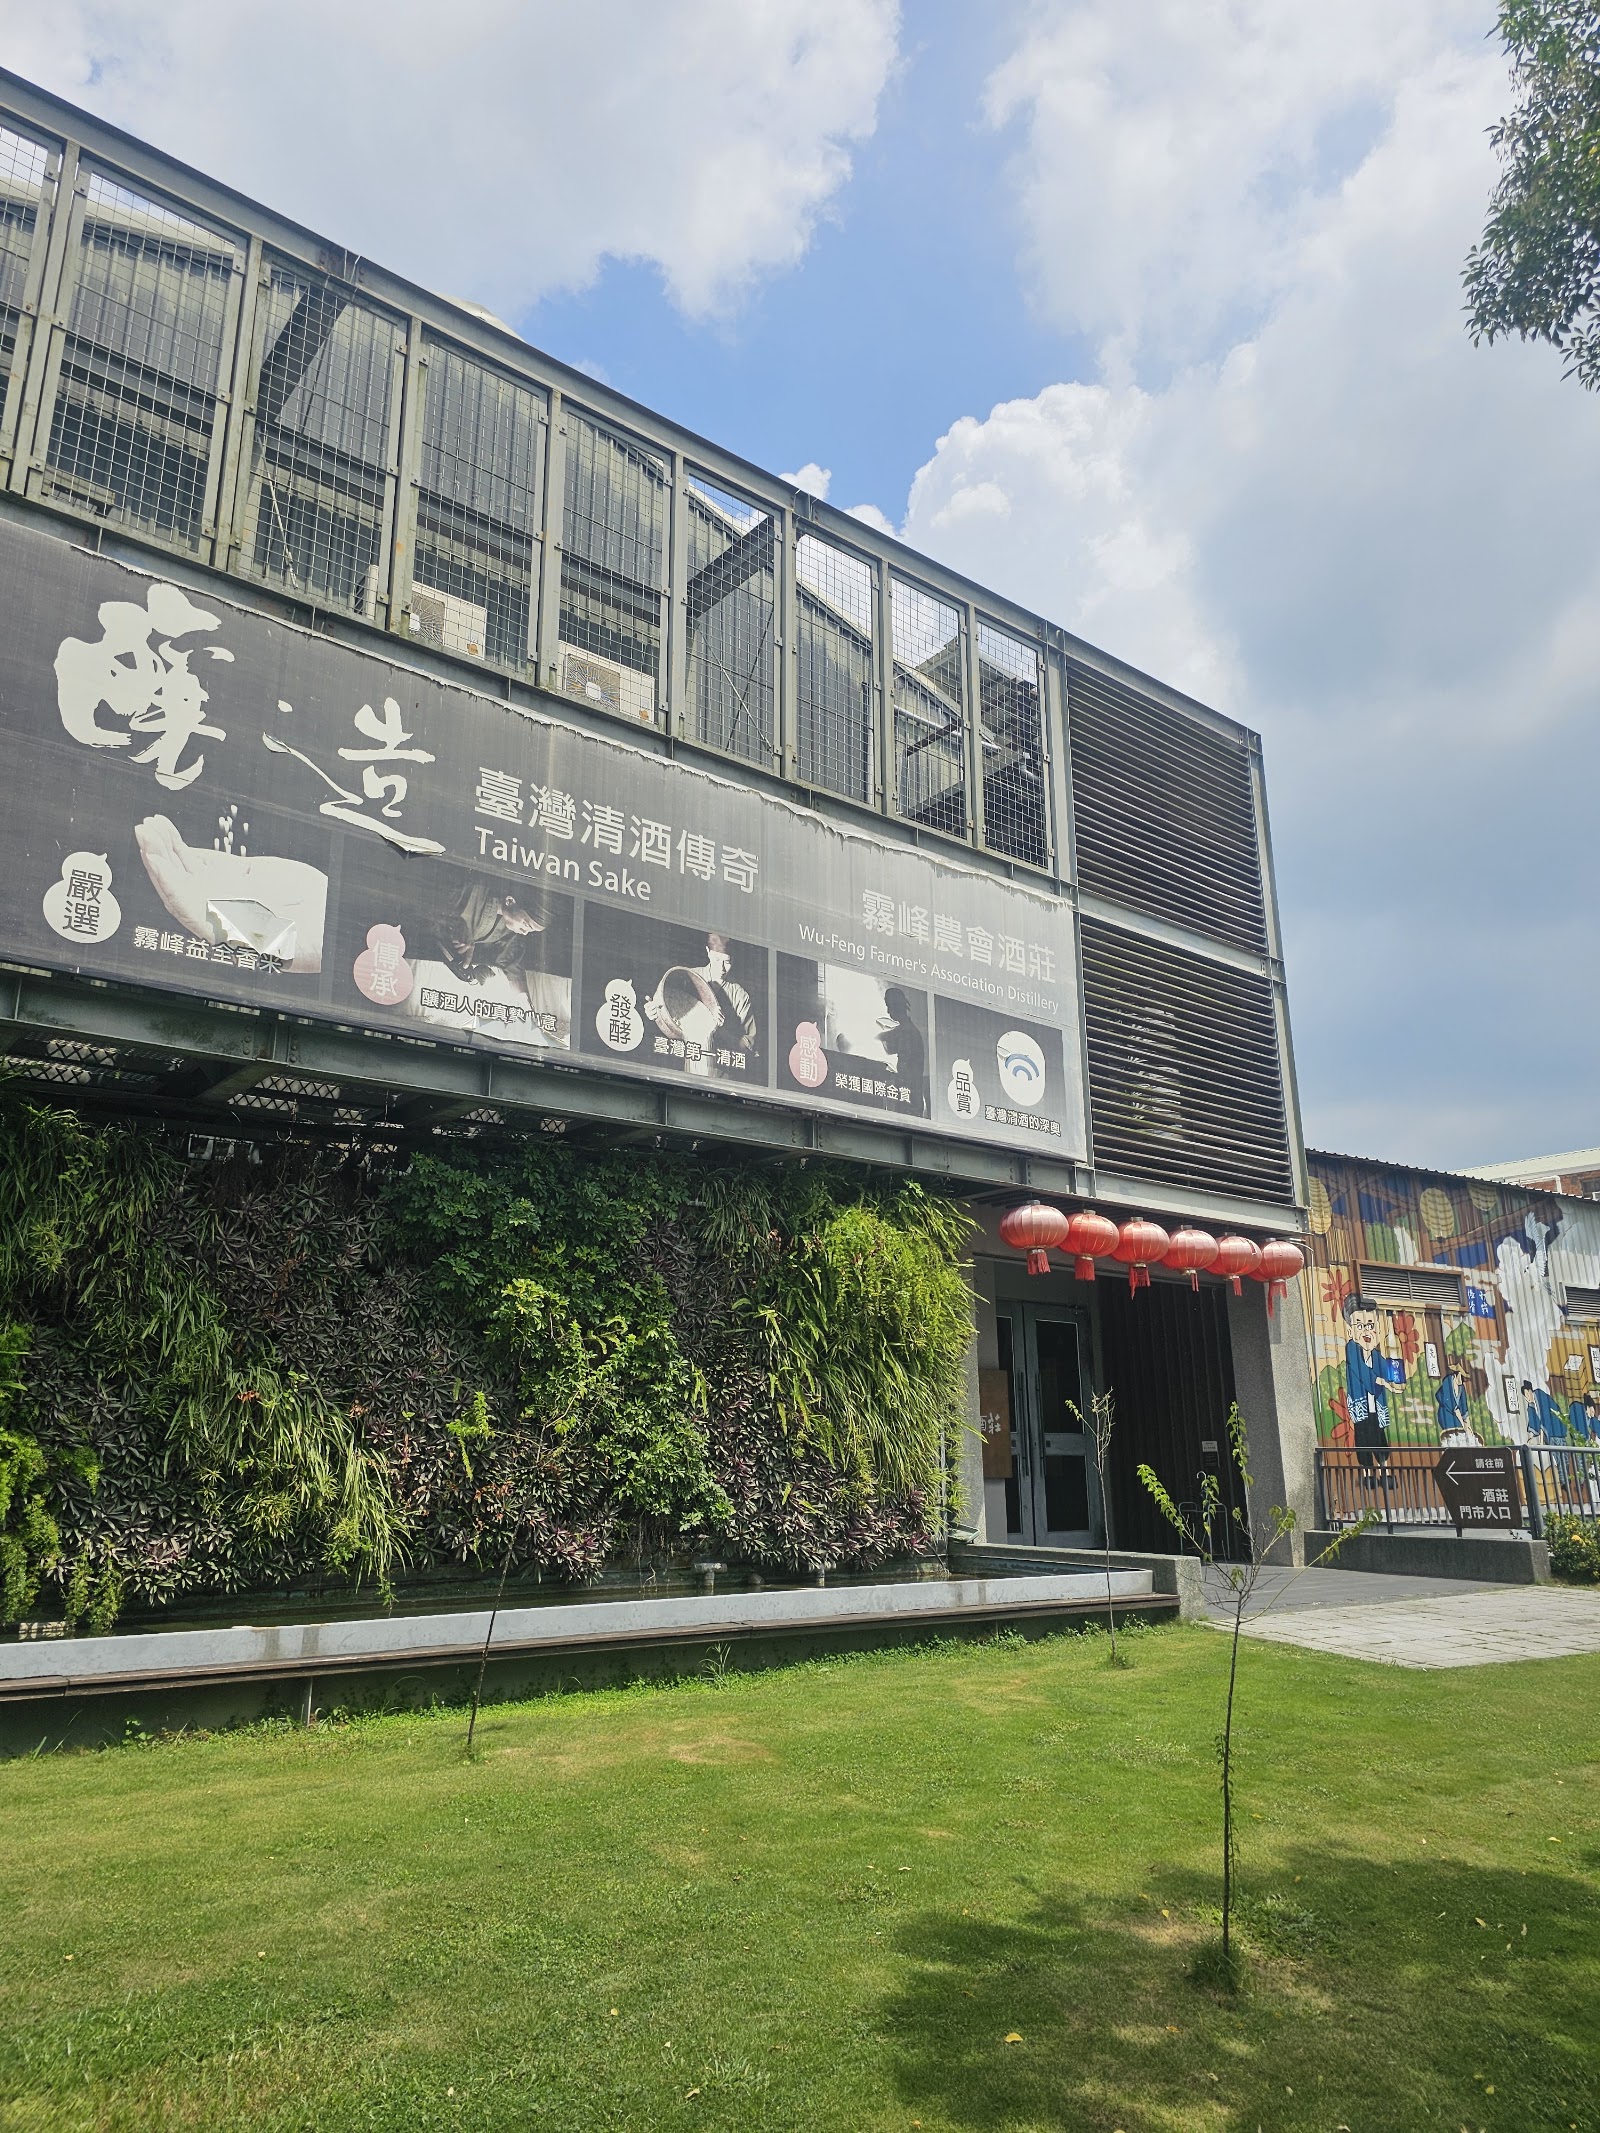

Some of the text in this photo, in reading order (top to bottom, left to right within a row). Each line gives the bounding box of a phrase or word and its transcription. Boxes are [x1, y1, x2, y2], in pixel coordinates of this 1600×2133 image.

[474, 766, 759, 894] 臺灣清酒傳奇
[474, 825, 651, 901] Taiwan Sake
[62, 869, 103, 936] 嚴選
[133, 925, 282, 974] 霧峰益全香米
[862, 888, 1056, 984] 霧峰農會酒莊
[370, 939, 399, 997] 傳承
[799, 923, 1059, 1014] Wu-Feng Farmer's Association Distillery
[609, 993, 631, 1045] 發酵
[654, 1036, 746, 1070] 臺灣第一清酒
[799, 1036, 818, 1082] 感動
[835, 1072, 911, 1103] 榮獲國際金賞
[956, 1071, 971, 1114] 品賞
[1459, 1505, 1511, 1519] 門市入口
[1482, 1488, 1509, 1502] 酒莊
